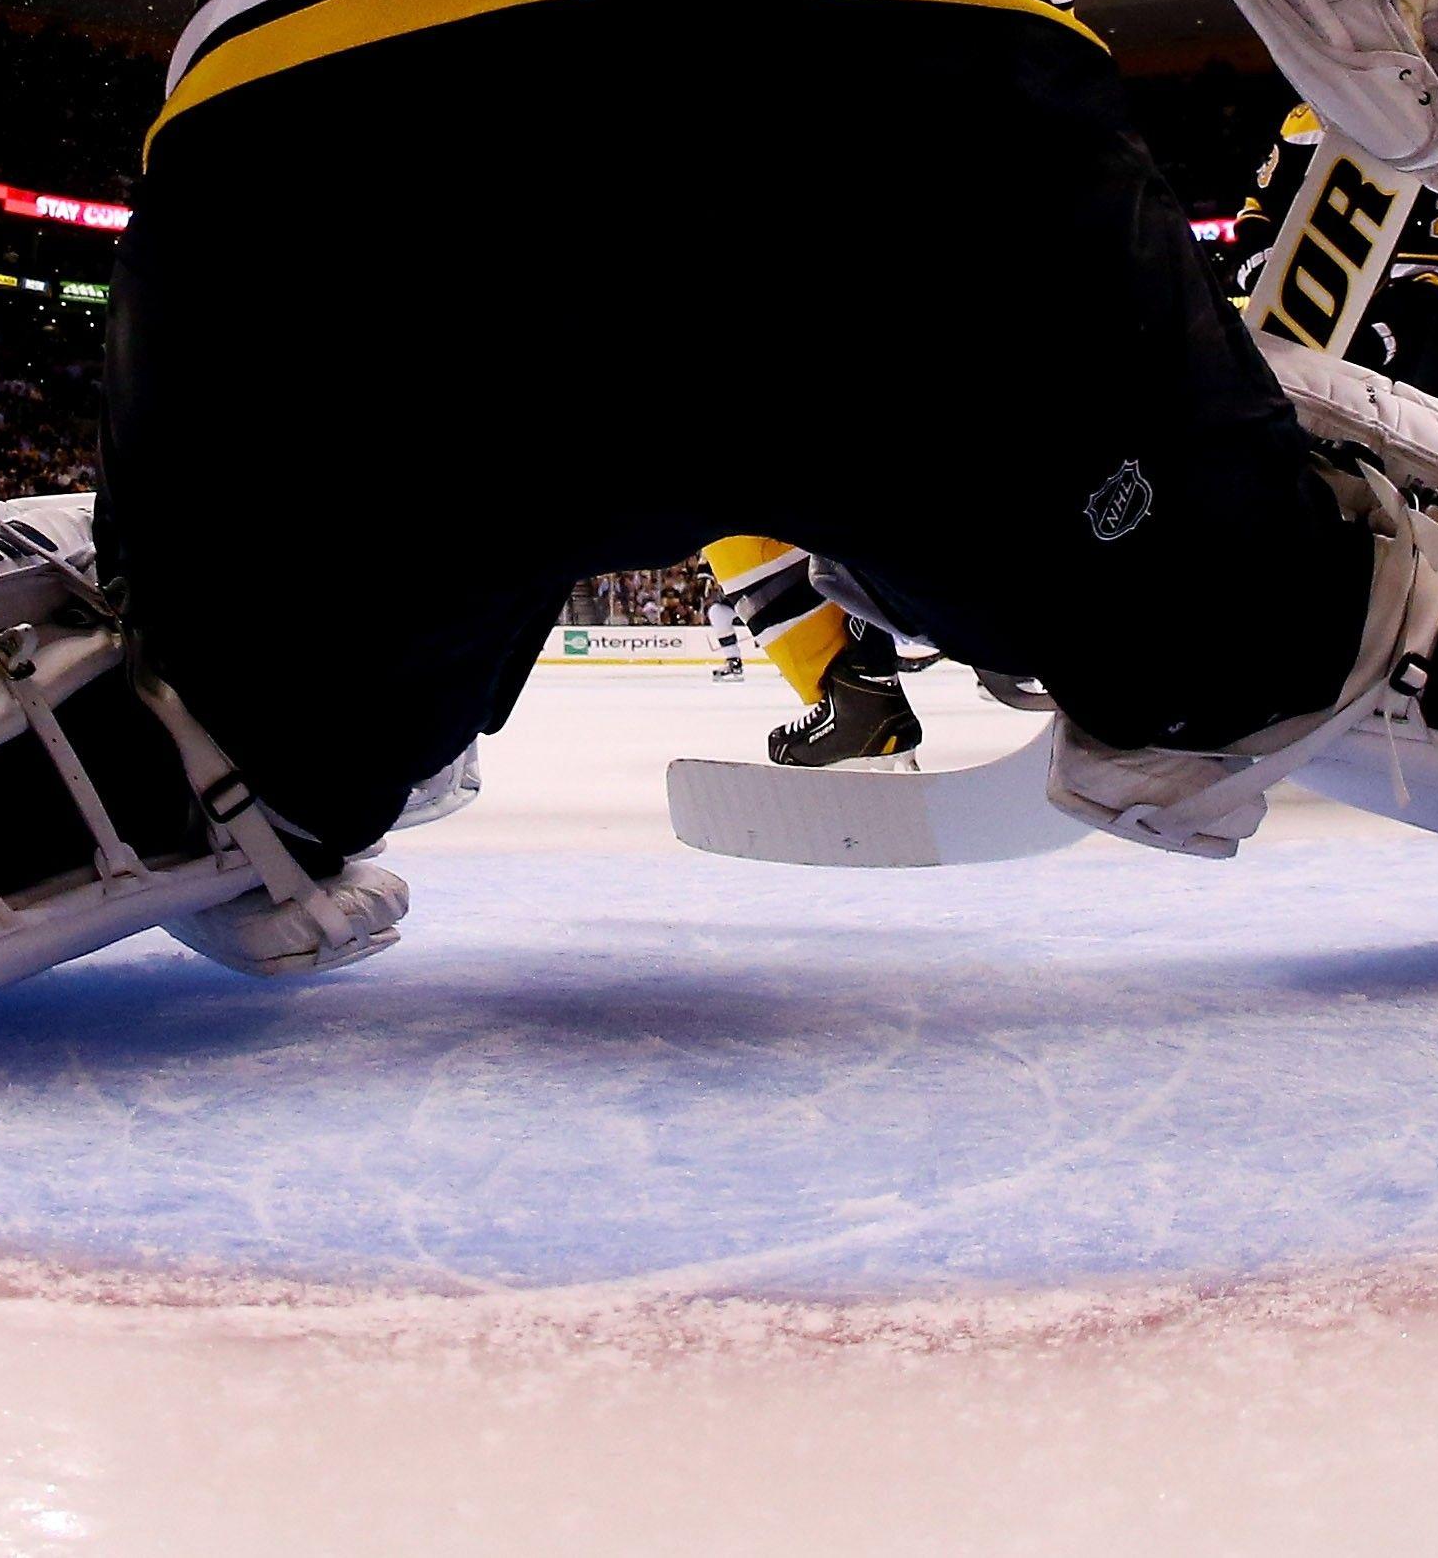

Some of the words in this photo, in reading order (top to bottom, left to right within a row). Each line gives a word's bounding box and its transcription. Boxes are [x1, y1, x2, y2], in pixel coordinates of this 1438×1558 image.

[36, 194, 81, 222] STAY
[1106, 482, 1134, 529] NHL
[569, 633, 683, 651] enterprise
